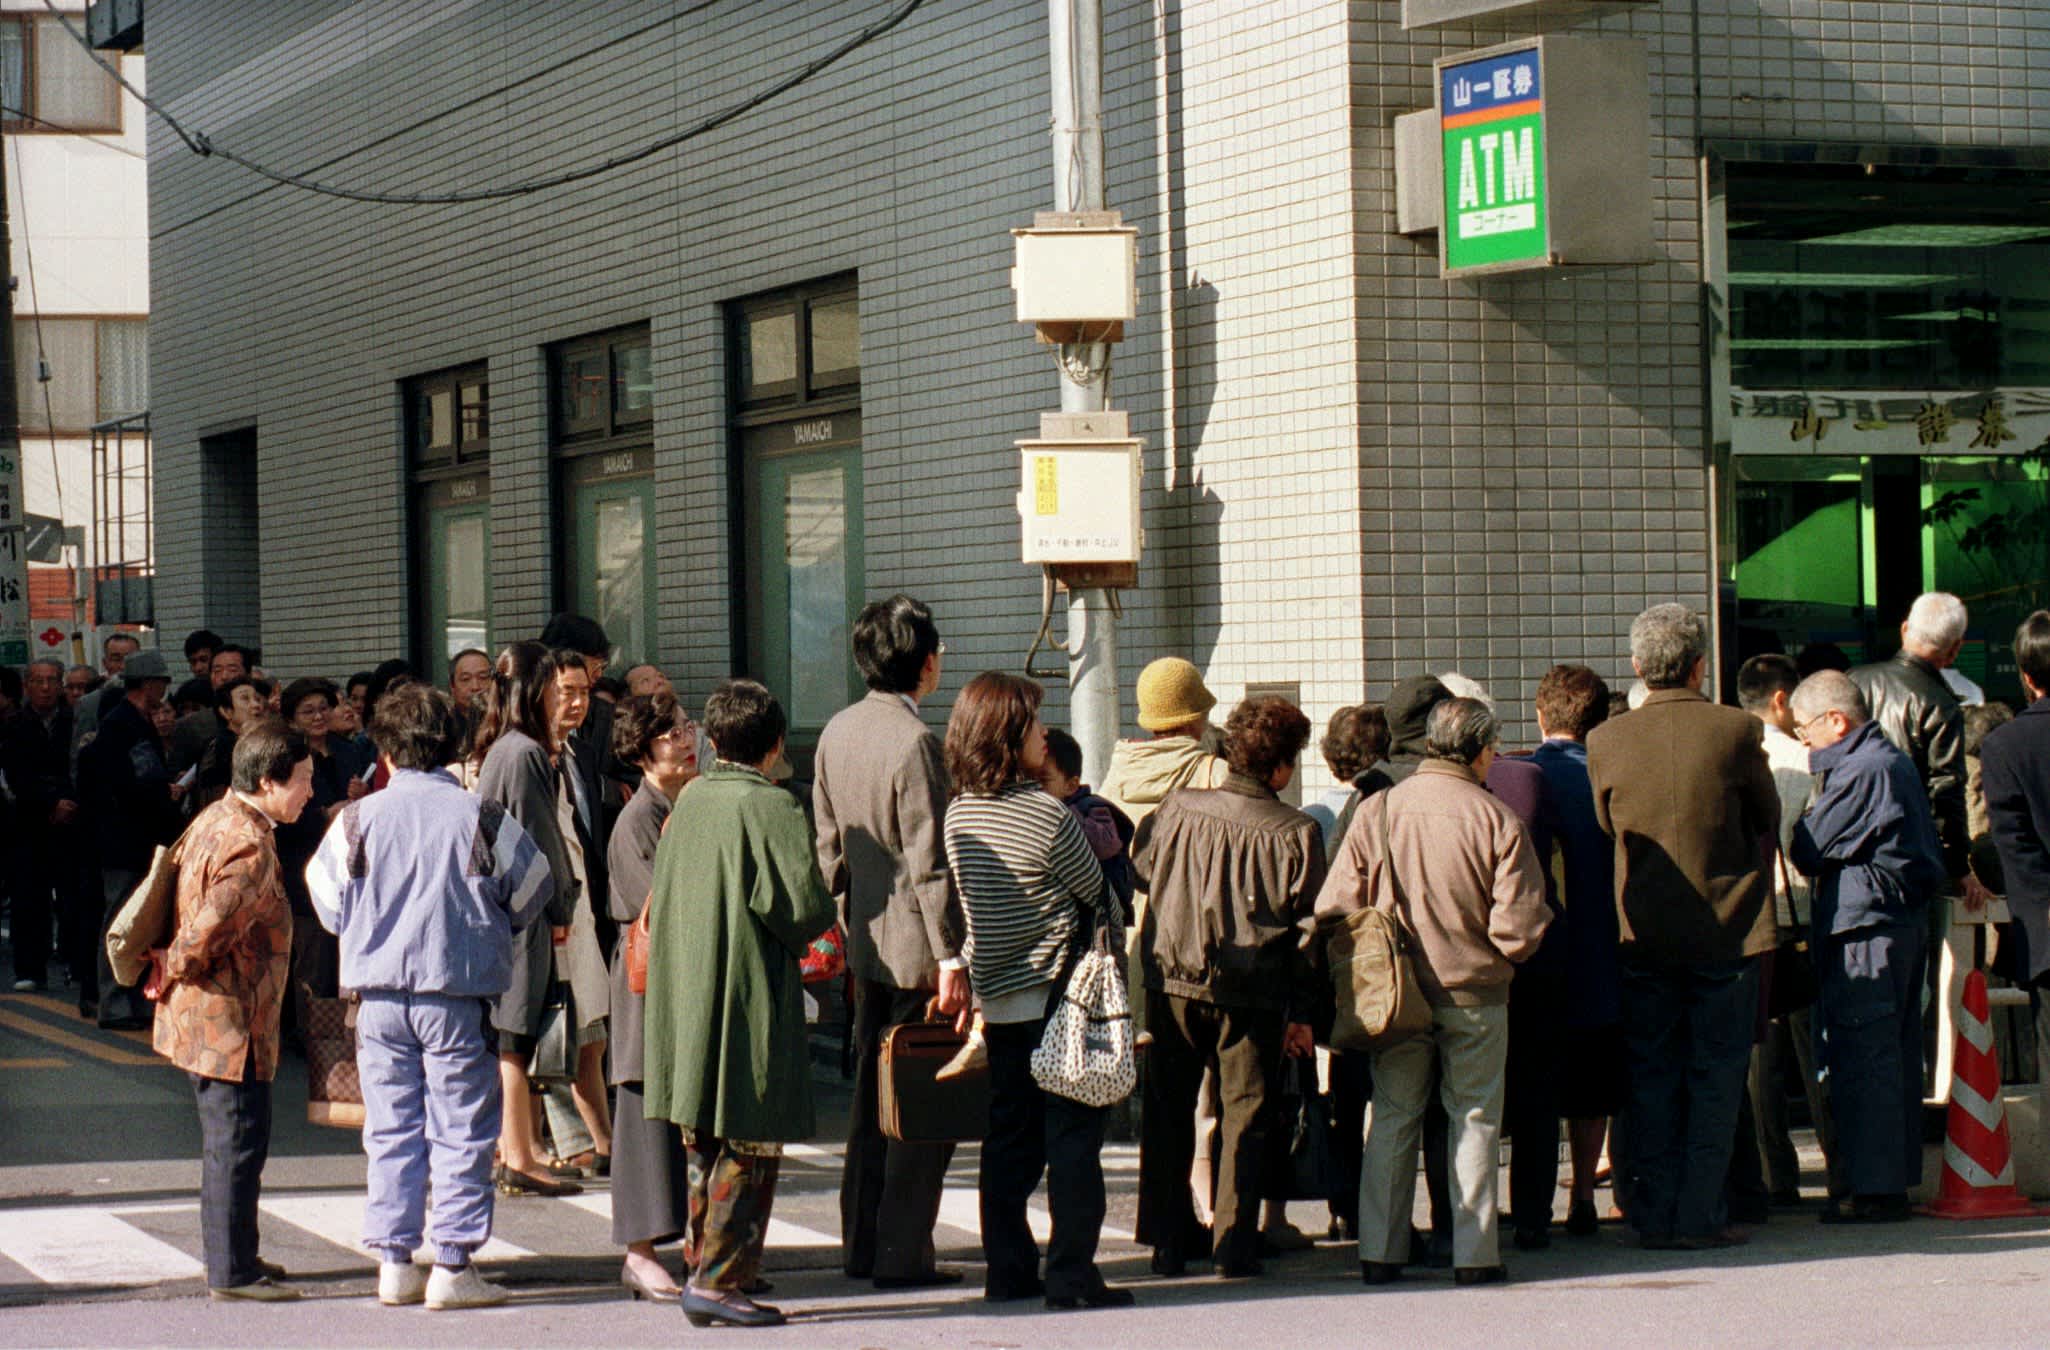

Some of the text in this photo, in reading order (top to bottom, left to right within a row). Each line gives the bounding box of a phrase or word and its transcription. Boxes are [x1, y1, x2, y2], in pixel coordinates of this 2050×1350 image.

[1452, 64, 1533, 108] 山一証券
[1458, 126, 1535, 210] ATM
[1473, 211, 1518, 231] コーナー
[792, 420, 832, 444] YAMAICHI
